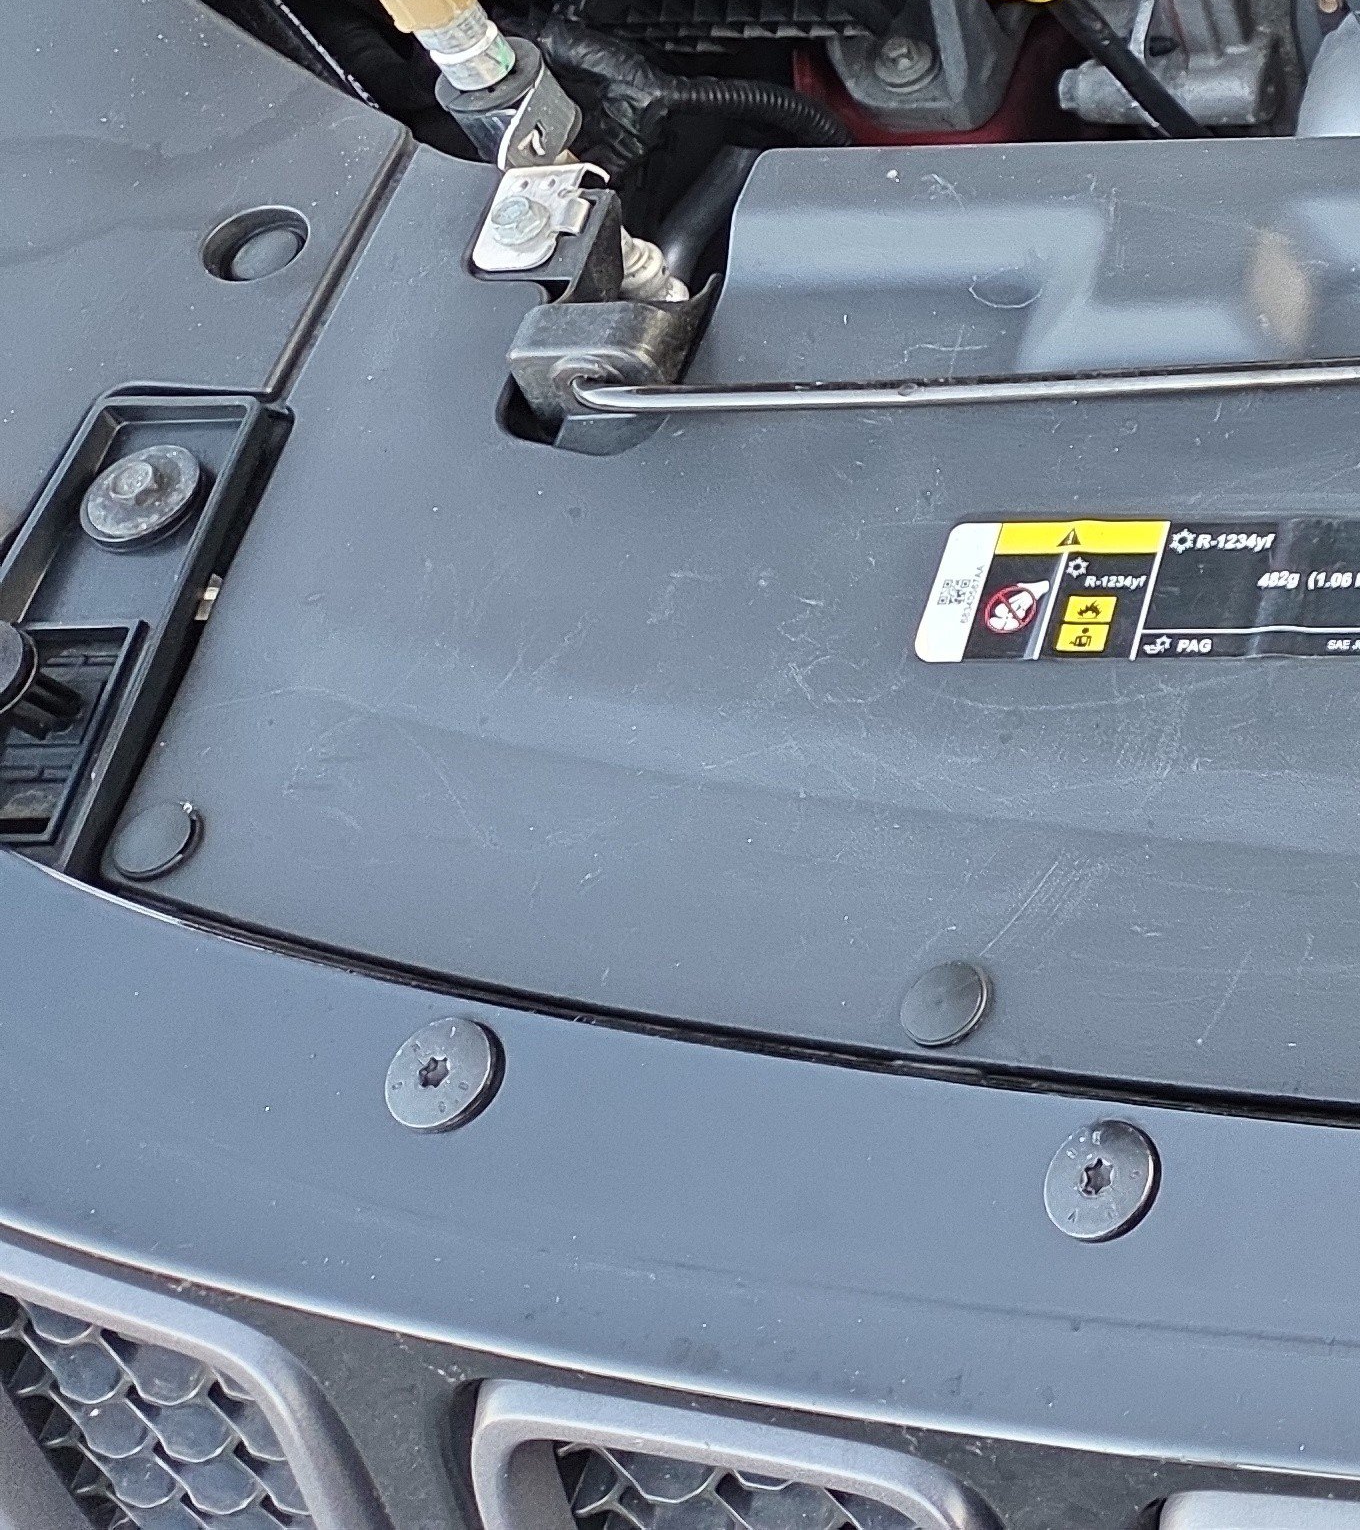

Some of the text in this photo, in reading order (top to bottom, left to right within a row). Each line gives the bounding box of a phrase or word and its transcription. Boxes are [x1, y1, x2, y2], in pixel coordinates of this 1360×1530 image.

[1195, 531, 1276, 551] R-1234yf
[1084, 574, 1147, 590] R-1234yf
[1177, 638, 1213, 653] PAG
[1326, 639, 1351, 650] SAE
